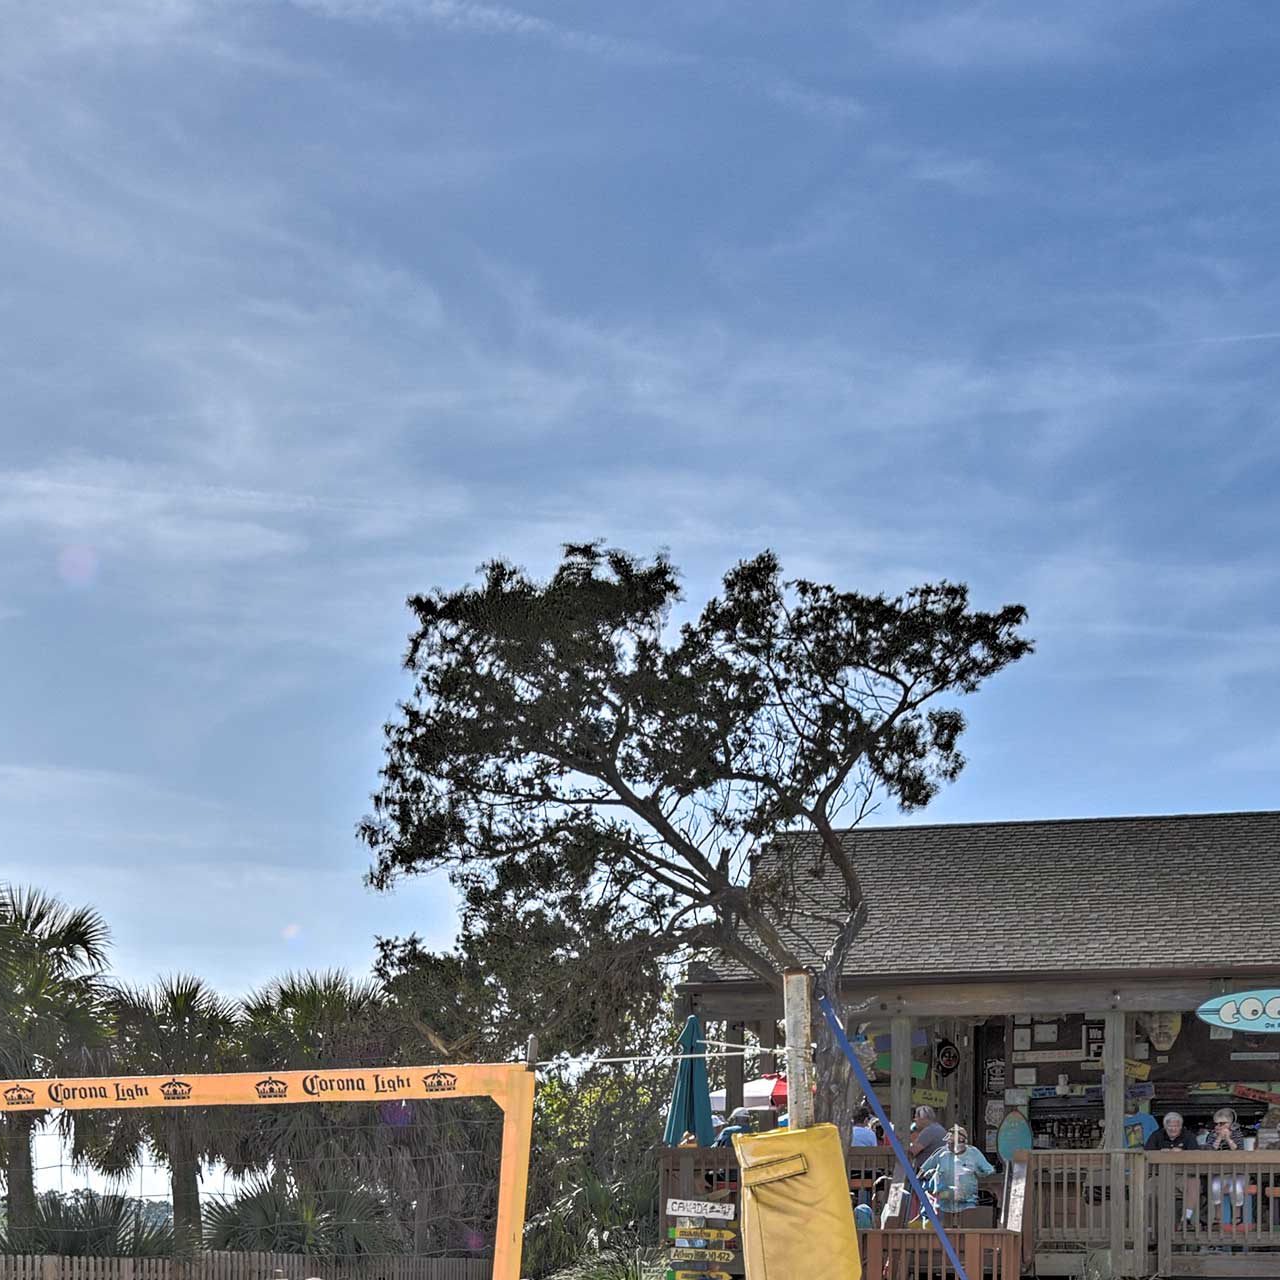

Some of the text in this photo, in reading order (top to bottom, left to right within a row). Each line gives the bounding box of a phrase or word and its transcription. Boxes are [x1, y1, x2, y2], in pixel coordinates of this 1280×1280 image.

[47, 1082, 150, 1106] Corona Light
[302, 1074, 411, 1098] Corona Light
[671, 1201, 708, 1215] CANADA
